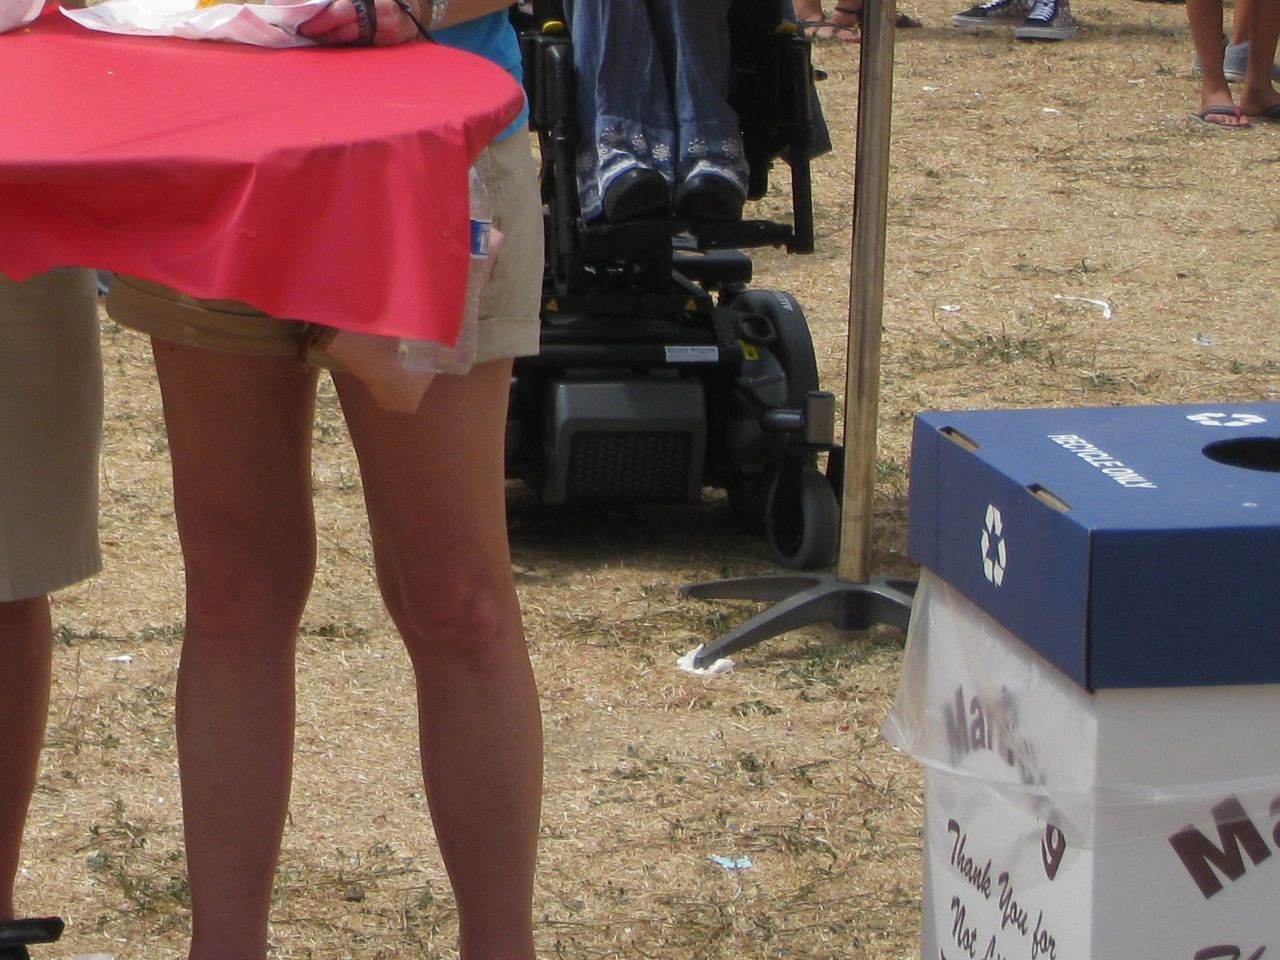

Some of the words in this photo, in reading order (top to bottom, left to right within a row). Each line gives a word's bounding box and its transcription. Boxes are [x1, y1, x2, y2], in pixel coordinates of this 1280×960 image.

[1046, 434, 1125, 468] RECYCLE
[1101, 467, 1158, 489] ONLY
[947, 819, 992, 900] Thank
[997, 871, 1029, 937] You
[1031, 909, 1057, 960] for
[950, 895, 978, 959] Not
